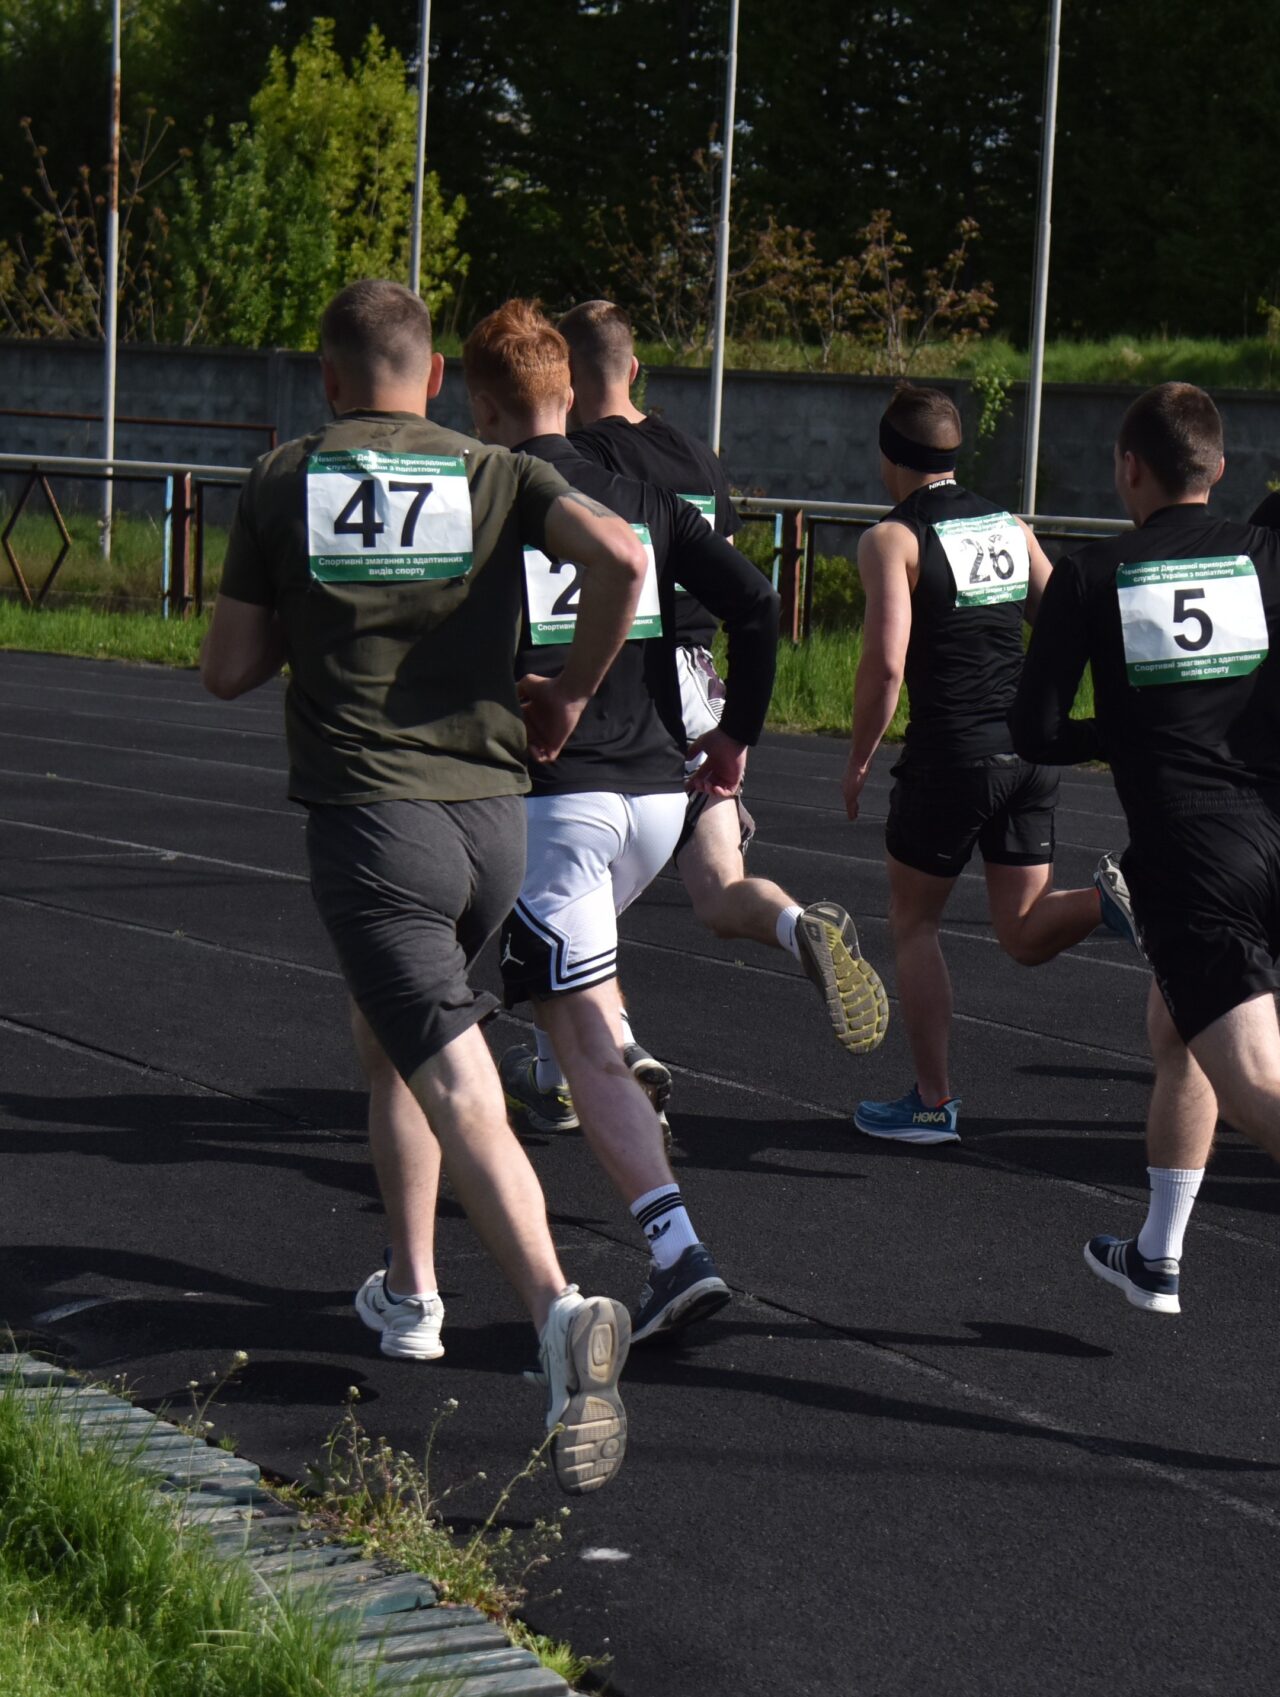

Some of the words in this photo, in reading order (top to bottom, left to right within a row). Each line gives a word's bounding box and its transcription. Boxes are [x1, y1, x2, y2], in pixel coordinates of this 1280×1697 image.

[334, 479, 434, 548] 47
[319, 558, 363, 566] Спортивні
[369, 567, 393, 576] видів
[395, 567, 425, 576] спорту
[960, 533, 1015, 584] 26
[549, 560, 582, 616] 2
[1173, 588, 1213, 651] 5
[912, 1112, 946, 1123] HOKA
